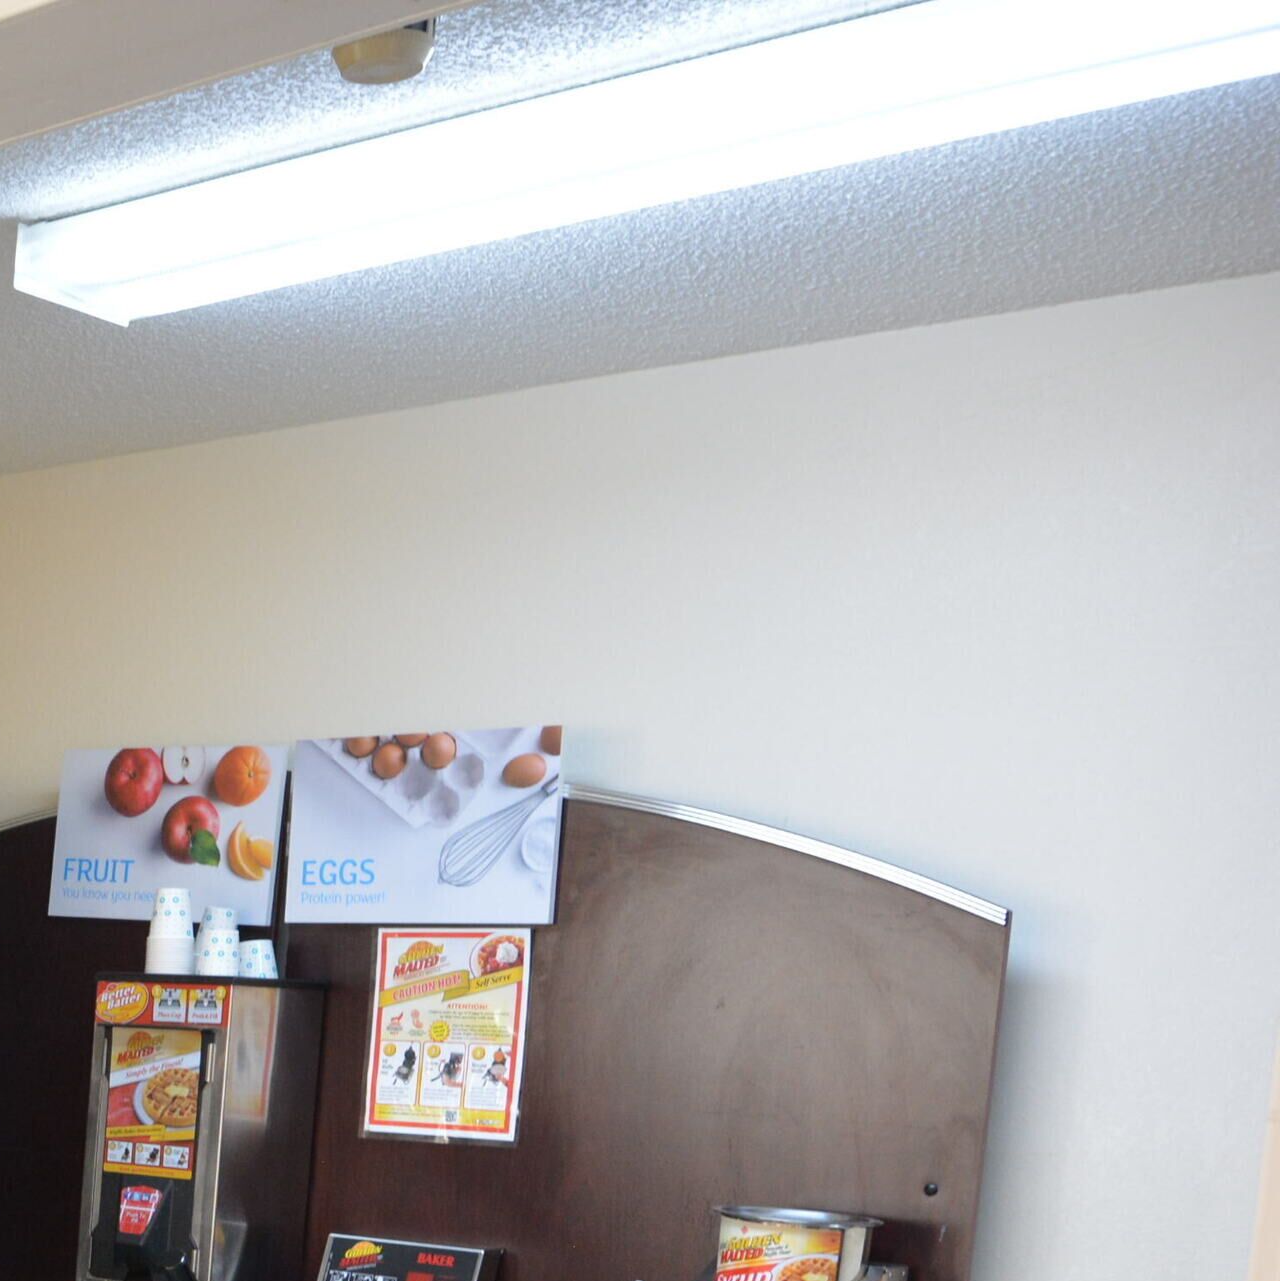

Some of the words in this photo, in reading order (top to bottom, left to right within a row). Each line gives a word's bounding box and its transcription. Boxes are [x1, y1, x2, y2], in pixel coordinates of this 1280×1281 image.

[63, 857, 135, 884] FRUIT
[302, 858, 375, 886] EGGS
[63, 887, 80, 898] You
[83, 887, 107, 900] know
[111, 890, 131, 904] you
[301, 891, 342, 904] Protein
[345, 891, 385, 908] power!
[393, 955, 441, 979] MALTED
[392, 983, 437, 1001] CAUTION
[438, 974, 462, 992] HOT!
[476, 978, 489, 989] Self
[490, 973, 512, 985] Serve
[117, 1046, 155, 1065] MALTED
[728, 1232, 782, 1249] GOLDEN
[417, 1252, 455, 1267] BAKER
[721, 1247, 765, 1264] MALTED
